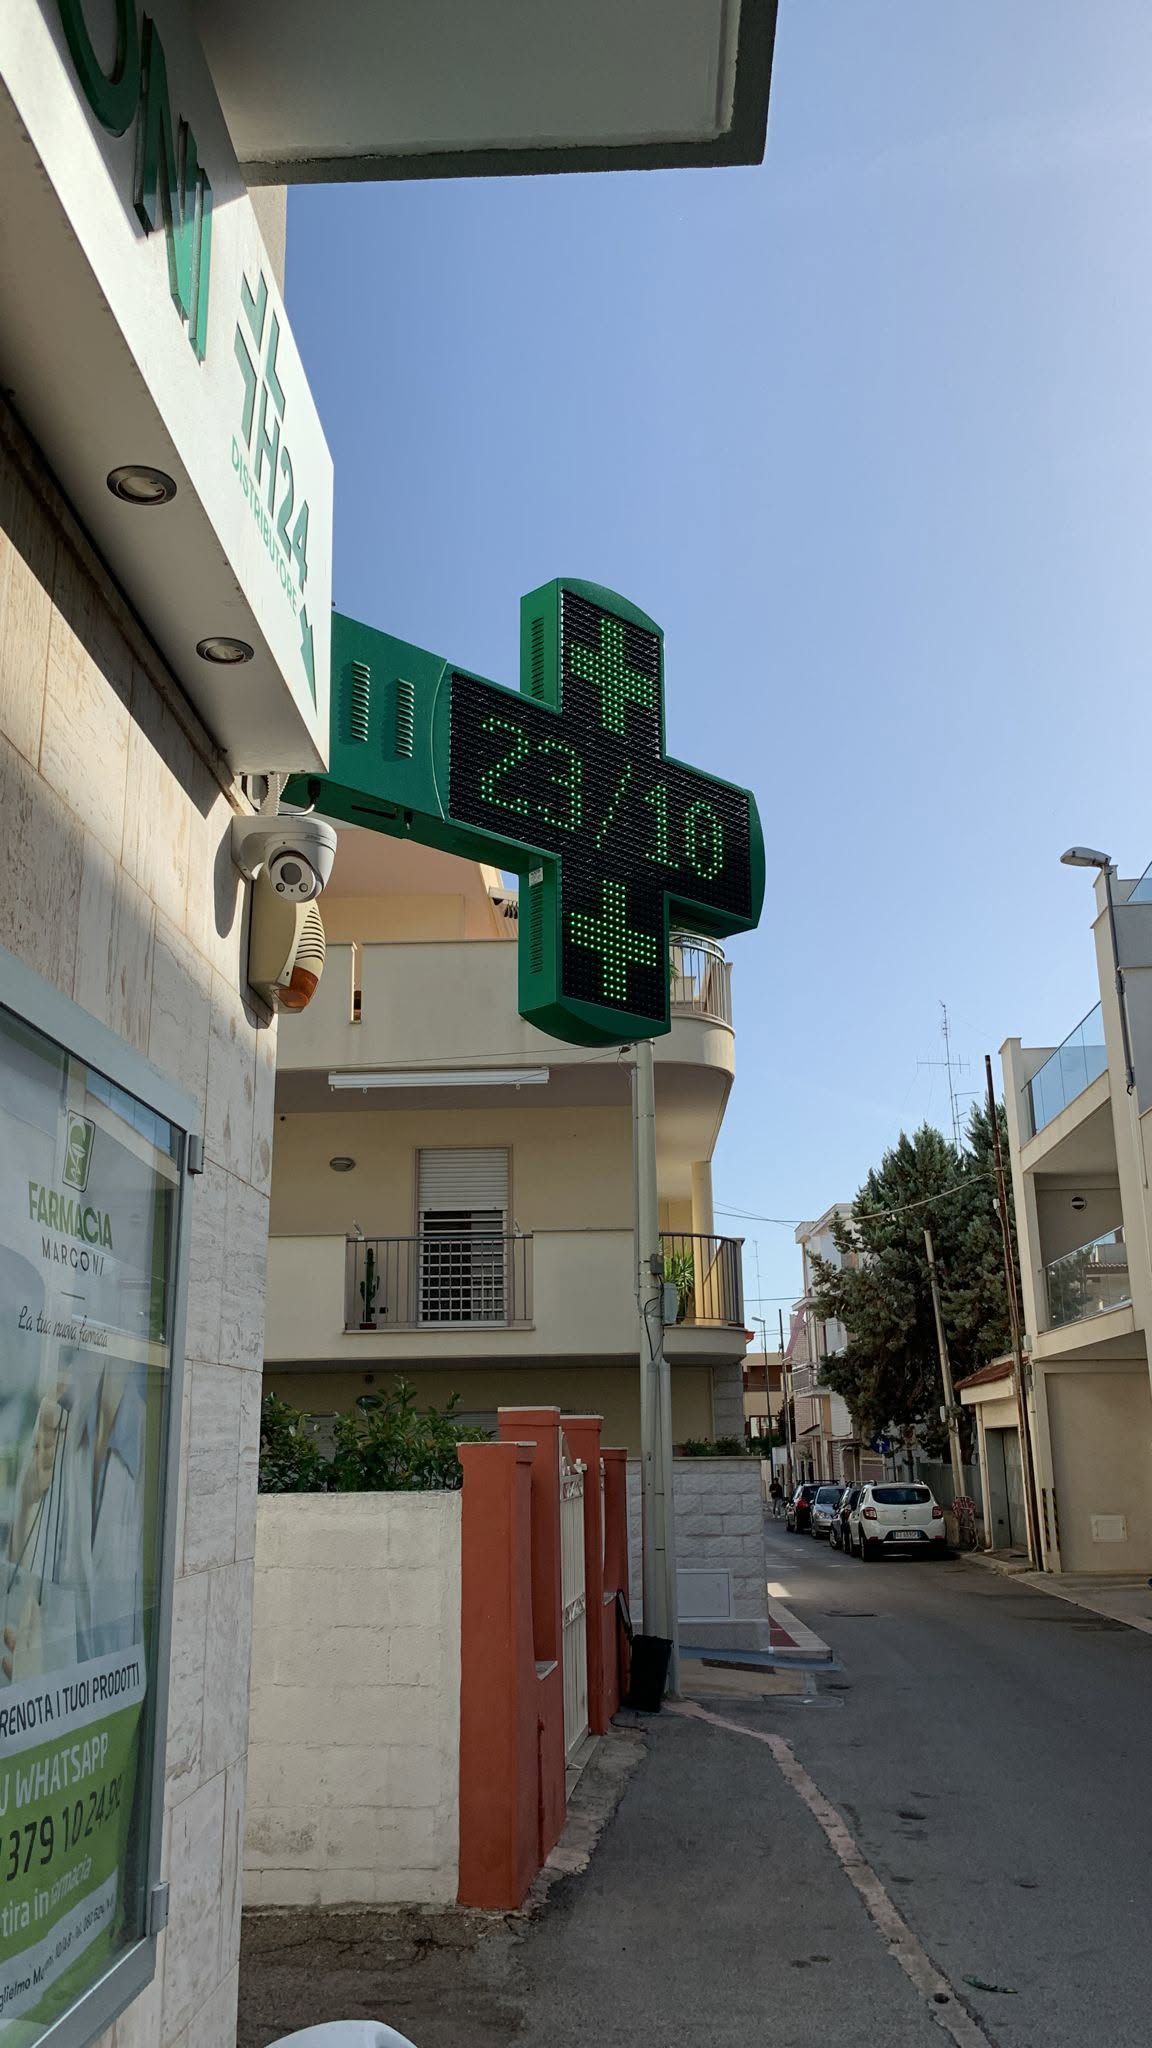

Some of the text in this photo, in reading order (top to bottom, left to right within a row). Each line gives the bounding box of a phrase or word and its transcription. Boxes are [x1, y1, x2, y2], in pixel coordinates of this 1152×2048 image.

[254, 380, 310, 595] H24
[231, 433, 298, 616] DISTRIBUTORE
[481, 716, 725, 881] 23/10
[28, 1181, 113, 1250] FARMACIA
[41, 1235, 105, 1277] MARCONI
[18, 1305, 33, 1332] La
[56, 1691, 61, 1718] I
[62, 1680, 90, 1715] TUOI
[92, 1661, 141, 1704] PRODOTTI
[15, 1731, 109, 1809] WHATSAPP
[6, 1815, 55, 1882] 379
[34, 1887, 49, 1921] in
